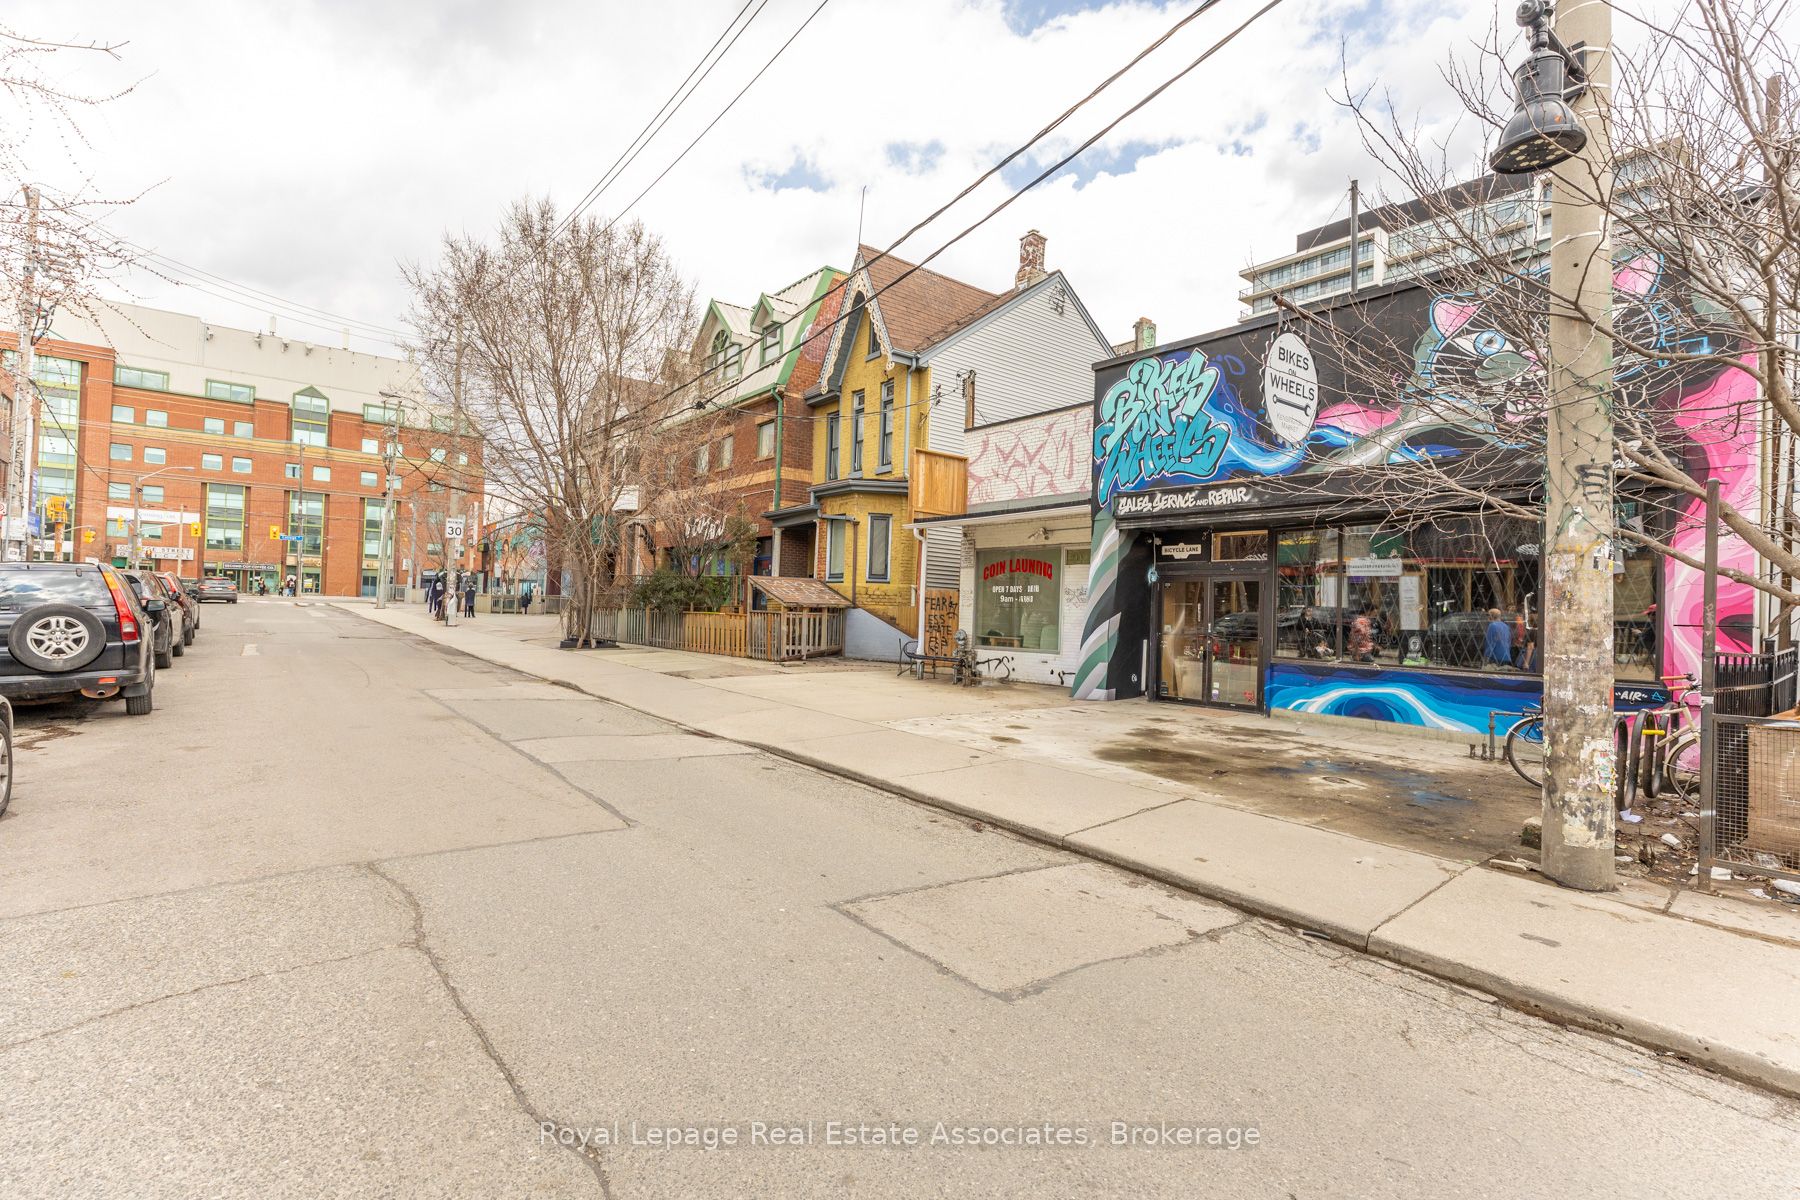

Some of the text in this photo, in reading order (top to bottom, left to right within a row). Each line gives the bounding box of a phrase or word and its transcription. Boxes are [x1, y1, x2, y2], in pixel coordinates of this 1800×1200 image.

[1278, 346, 1310, 371] BIKES
[1287, 368, 1297, 377] ON
[1270, 372, 1315, 402] WHEELS
[1101, 348, 1219, 455] BIKES
[1152, 490, 1197, 512] SERVICE
[1208, 487, 1250, 506] REPAIR
[447, 526, 462, 536] 30
[983, 560, 1006, 580] COIN
[992, 585, 1005, 593] OPEN
[1010, 585, 1023, 593] DAYS
[1000, 595, 1014, 603] 9am
